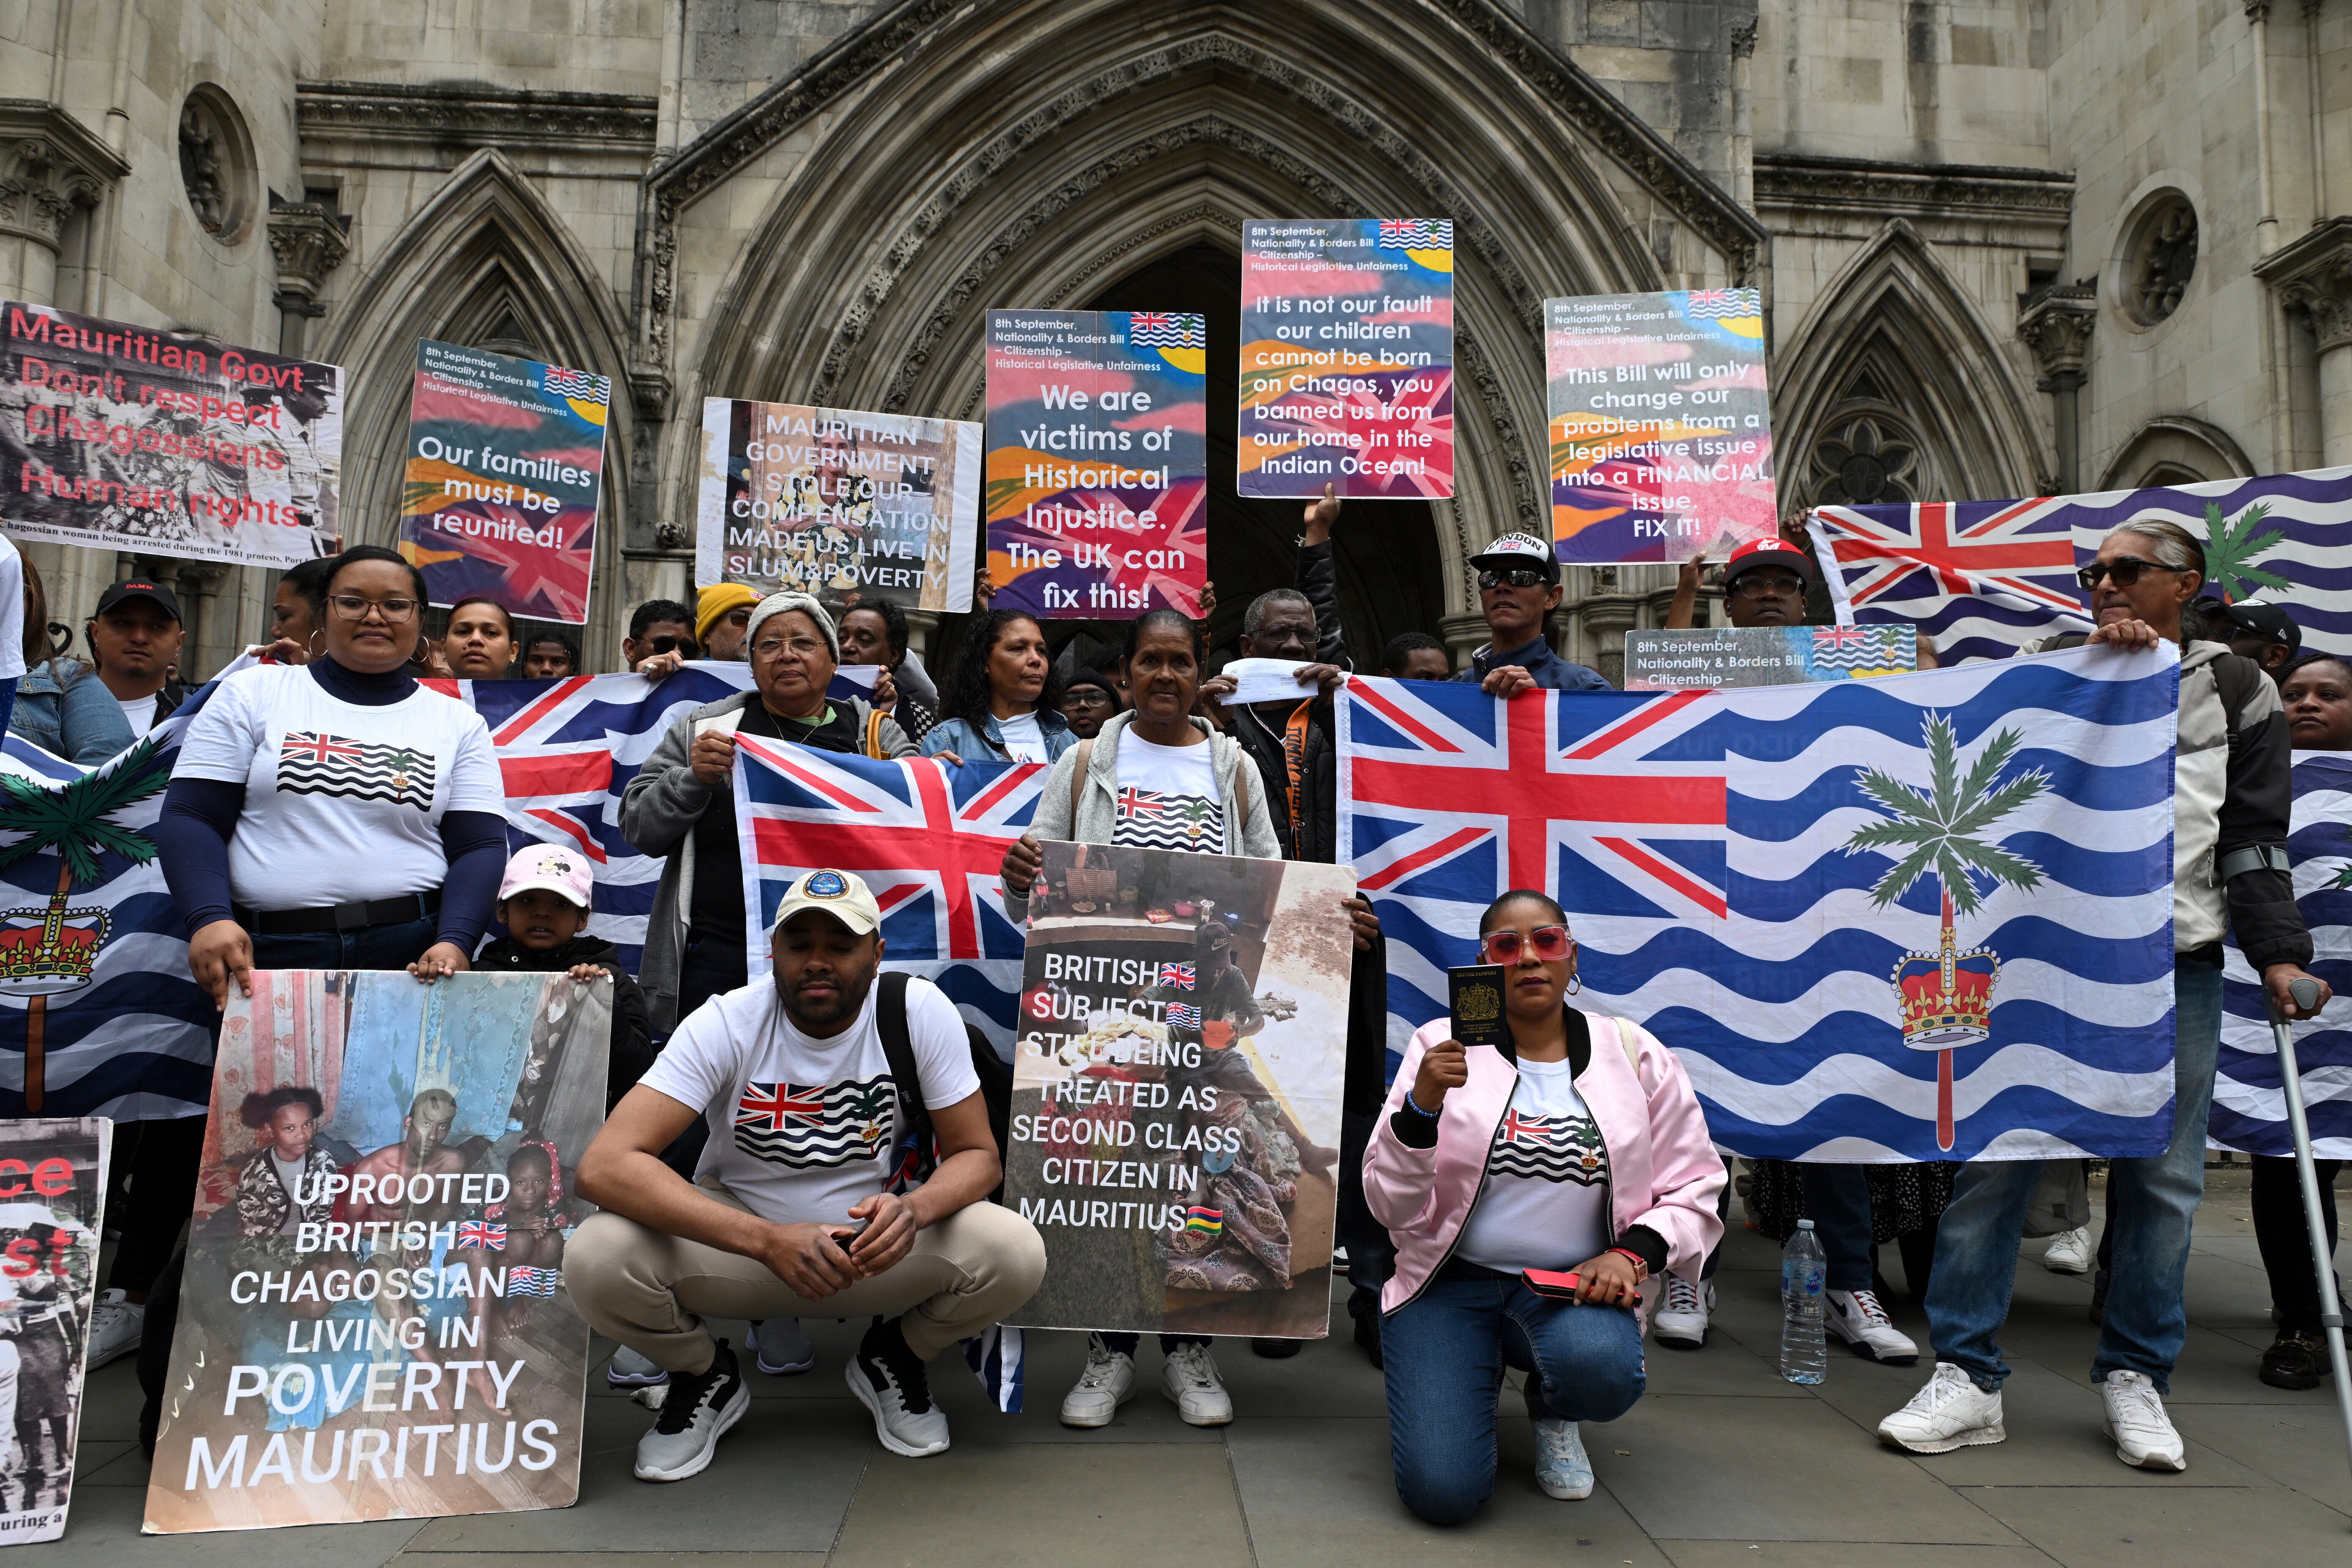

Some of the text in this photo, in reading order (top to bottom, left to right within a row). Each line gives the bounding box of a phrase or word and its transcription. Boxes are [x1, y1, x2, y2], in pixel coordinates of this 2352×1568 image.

[1252, 239, 1306, 249] Nationality
[1271, 228, 1329, 237] September,
[1260, 251, 1314, 260] Citizenship
[1257, 296, 1432, 313] It is not our fault
[995, 319, 1077, 330] 8th September,
[996, 332, 1124, 344] Nationality Borders Bill
[1277, 322, 1410, 339] our children
[11, 308, 304, 393] Mauritian Govt
[426, 348, 499, 370] 8th September,
[1005, 346, 1062, 358] Citizenship
[1256, 349, 1431, 365] cannot be born
[425, 359, 539, 389] Nationality Borders Bill
[996, 359, 1160, 371] Historical Legislative Unfairness
[1566, 360, 1749, 384] This Bill will only
[22, 356, 281, 429] Don't respect
[432, 372, 483, 390] Citizenship
[1253, 375, 1432, 396] on Chagos, you
[423, 382, 567, 416] Historical Legislative Unfairness
[1041, 384, 1151, 411] We are
[1255, 402, 1432, 420] banned us from
[1590, 389, 1729, 410] change our
[26, 405, 283, 470] Chagossians
[767, 414, 917, 445] MAURITIAN
[1020, 424, 1172, 451] victims of
[1253, 429, 1432, 447] our home in the
[1564, 413, 1736, 438] problems from
[419, 436, 591, 487] Our families
[746, 442, 934, 475] GOVERNMENT
[1570, 438, 1756, 463] legislative issue
[1025, 464, 1168, 490] Historical
[1261, 457, 1425, 475] Indian Ocean!
[1562, 463, 1768, 486] into FINANCIAL
[21, 462, 299, 527] Human rights
[444, 478, 560, 513] must be
[766, 473, 912, 501] STOLE OUR
[1633, 493, 1698, 511] issue.
[733, 500, 948, 533] COMPENSATION
[1027, 503, 1166, 534] Injustice.
[1634, 518, 1700, 537] FIX IT!
[434, 512, 563, 549] reunited!
[1487, 533, 1542, 552] LONDON
[63, 530, 98, 540] woman
[103, 534, 129, 545] being
[132, 539, 171, 548] arrested
[174, 541, 204, 554] during
[247, 553, 282, 563] protests,
[730, 527, 946, 562] MADE US LIVE IN
[1007, 542, 1185, 569] The UK can
[729, 556, 944, 590] SLUM&POVERTY
[1043, 582, 1149, 609] fix this!
[1637, 640, 1741, 654] 8th September,
[1638, 655, 1804, 671] Nationality Borders Bill
[1649, 675, 1721, 687] Citizenship
[1287, 727, 1302, 779] TOMMY
[1045, 953, 1159, 986] BRITISH
[1025, 1031, 1201, 1068] STILL BEING
[1037, 1078, 1217, 1111] TREATED AS
[1012, 1115, 1241, 1153] SECOND CLASS
[1043, 1158, 1197, 1191] CITIZEN IN
[293, 1173, 510, 1205] UPROOTED
[1020, 1198, 1185, 1231] MAURITIUS
[296, 1222, 456, 1252] BRITISH
[230, 1266, 506, 1304] CHAGOSSIAN
[286, 1317, 480, 1352] LIVING IN
[223, 1360, 526, 1416] POVERTY
[184, 1419, 558, 1491] MAURITIUS
[54, 1513, 62, 1523] a
